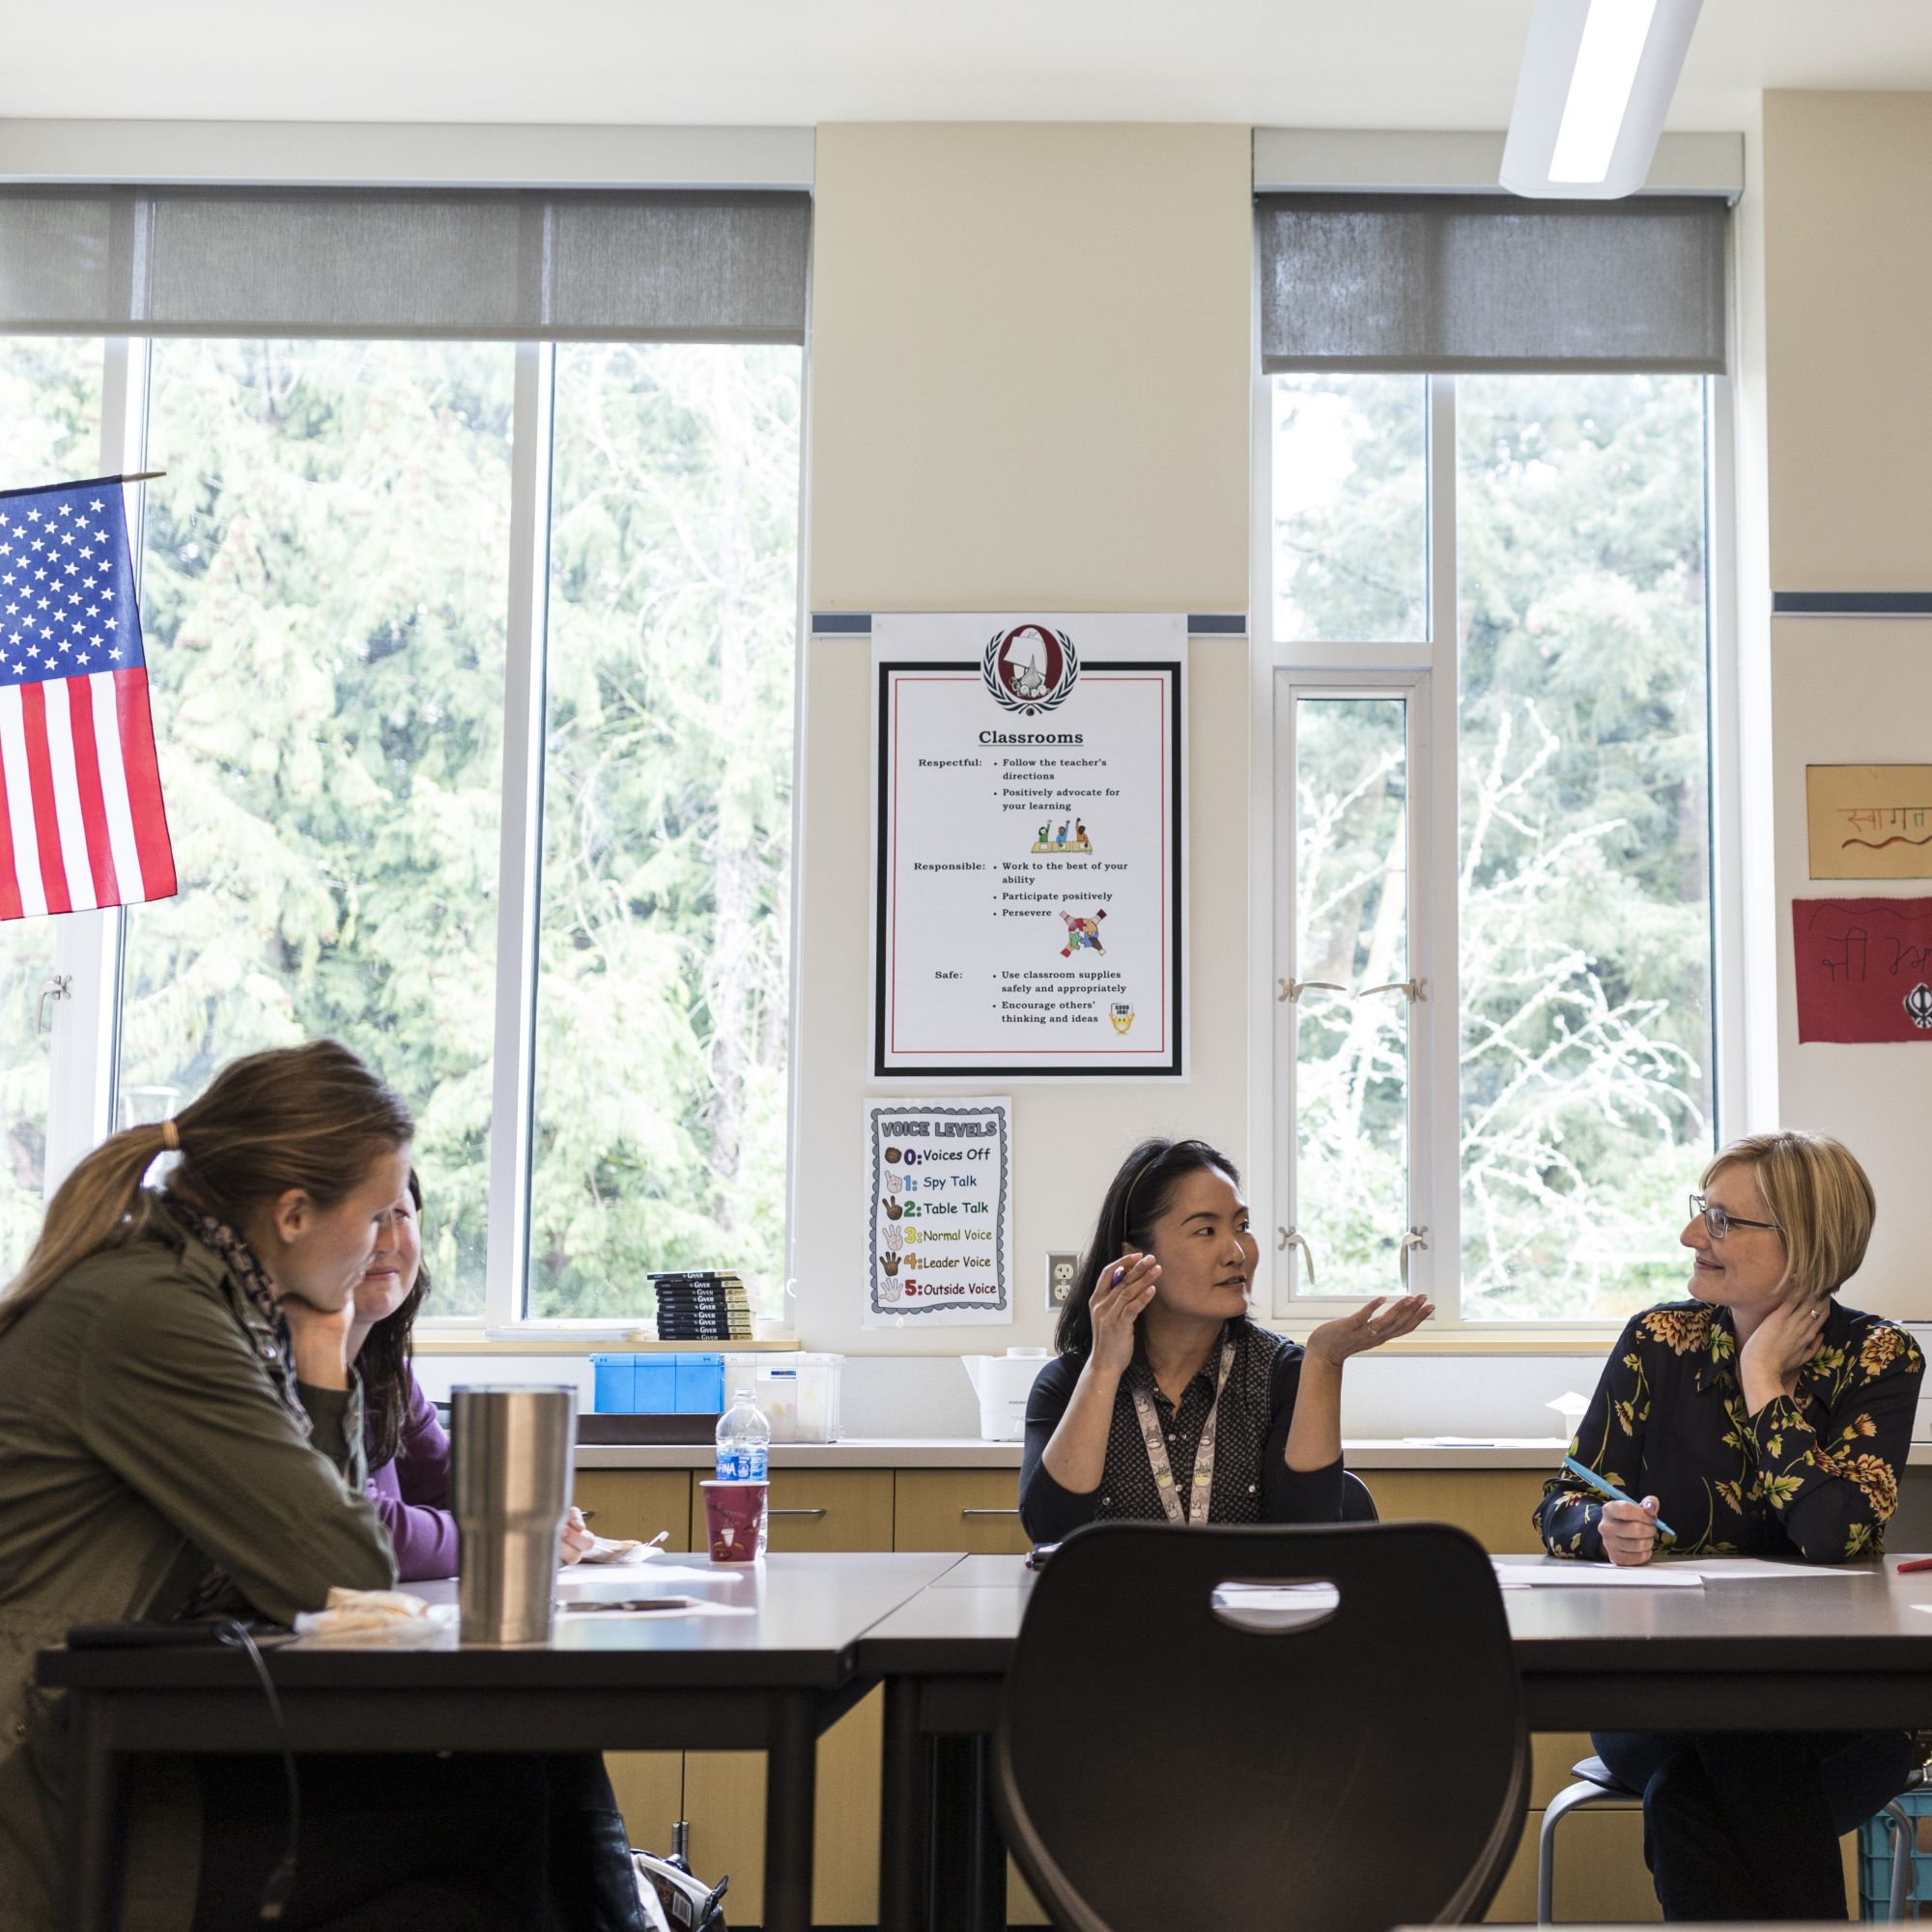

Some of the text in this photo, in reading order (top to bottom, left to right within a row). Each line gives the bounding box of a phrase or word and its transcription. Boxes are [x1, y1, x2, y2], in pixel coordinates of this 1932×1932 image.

[979, 730, 1083, 744] Classrooms
[918, 758, 982, 769] Respectful:
[1002, 758, 1107, 767] Follow the teacher's
[1002, 772, 1055, 781] directions
[1002, 788, 1121, 799] Positively advocate for
[1002, 802, 1072, 812] your learning
[913, 863, 986, 873] Responsible:
[1045, 862, 1064, 870] the
[1065, 862, 1089, 870] best
[1091, 862, 1103, 870] of
[1103, 864, 1128, 872] your
[1002, 876, 1036, 886] ability
[1002, 892, 1113, 902] Participate positively
[934, 971, 963, 980] Safe:
[1001, 971, 1122, 981] Use classroom supplies
[1001, 984, 1127, 995] safely and appropriately
[1001, 1001, 1095, 1011] Encourage others'
[1001, 1014, 1047, 1025] thinking
[1071, 1014, 1098, 1023] ideas
[882, 1122, 997, 1137] VOICE LEVELS
[923, 1150, 962, 1161] Voices
[967, 1149, 990, 1160] Off
[904, 1175, 977, 1191] 1: Spy Talk
[924, 1204, 957, 1214] Table
[962, 1203, 988, 1213] Talk
[923, 1230, 960, 1241] Normal
[965, 1231, 992, 1240] Voice
[923, 1257, 959, 1268] Leader
[963, 1257, 990, 1267] Voice
[924, 1284, 966, 1294] Outside
[970, 1284, 996, 1293] Voice
